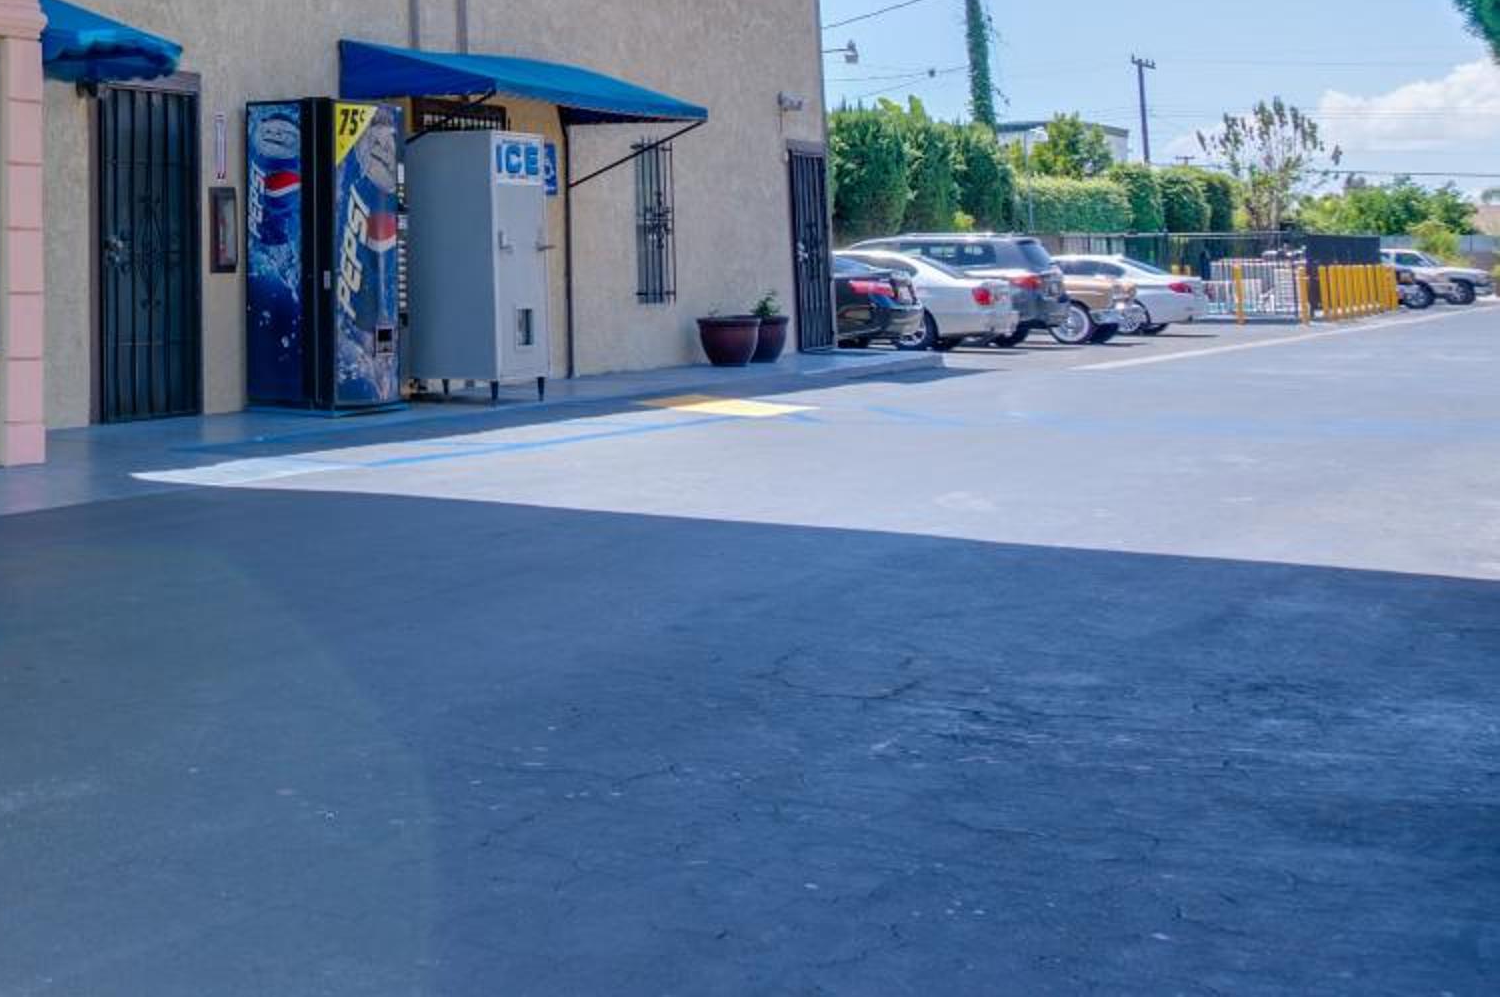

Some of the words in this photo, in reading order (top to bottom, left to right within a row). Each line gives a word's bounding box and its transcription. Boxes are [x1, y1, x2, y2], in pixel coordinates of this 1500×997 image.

[496, 144, 538, 175] ICE
[248, 161, 266, 238] PEPSI
[337, 185, 371, 318] PEPSI
